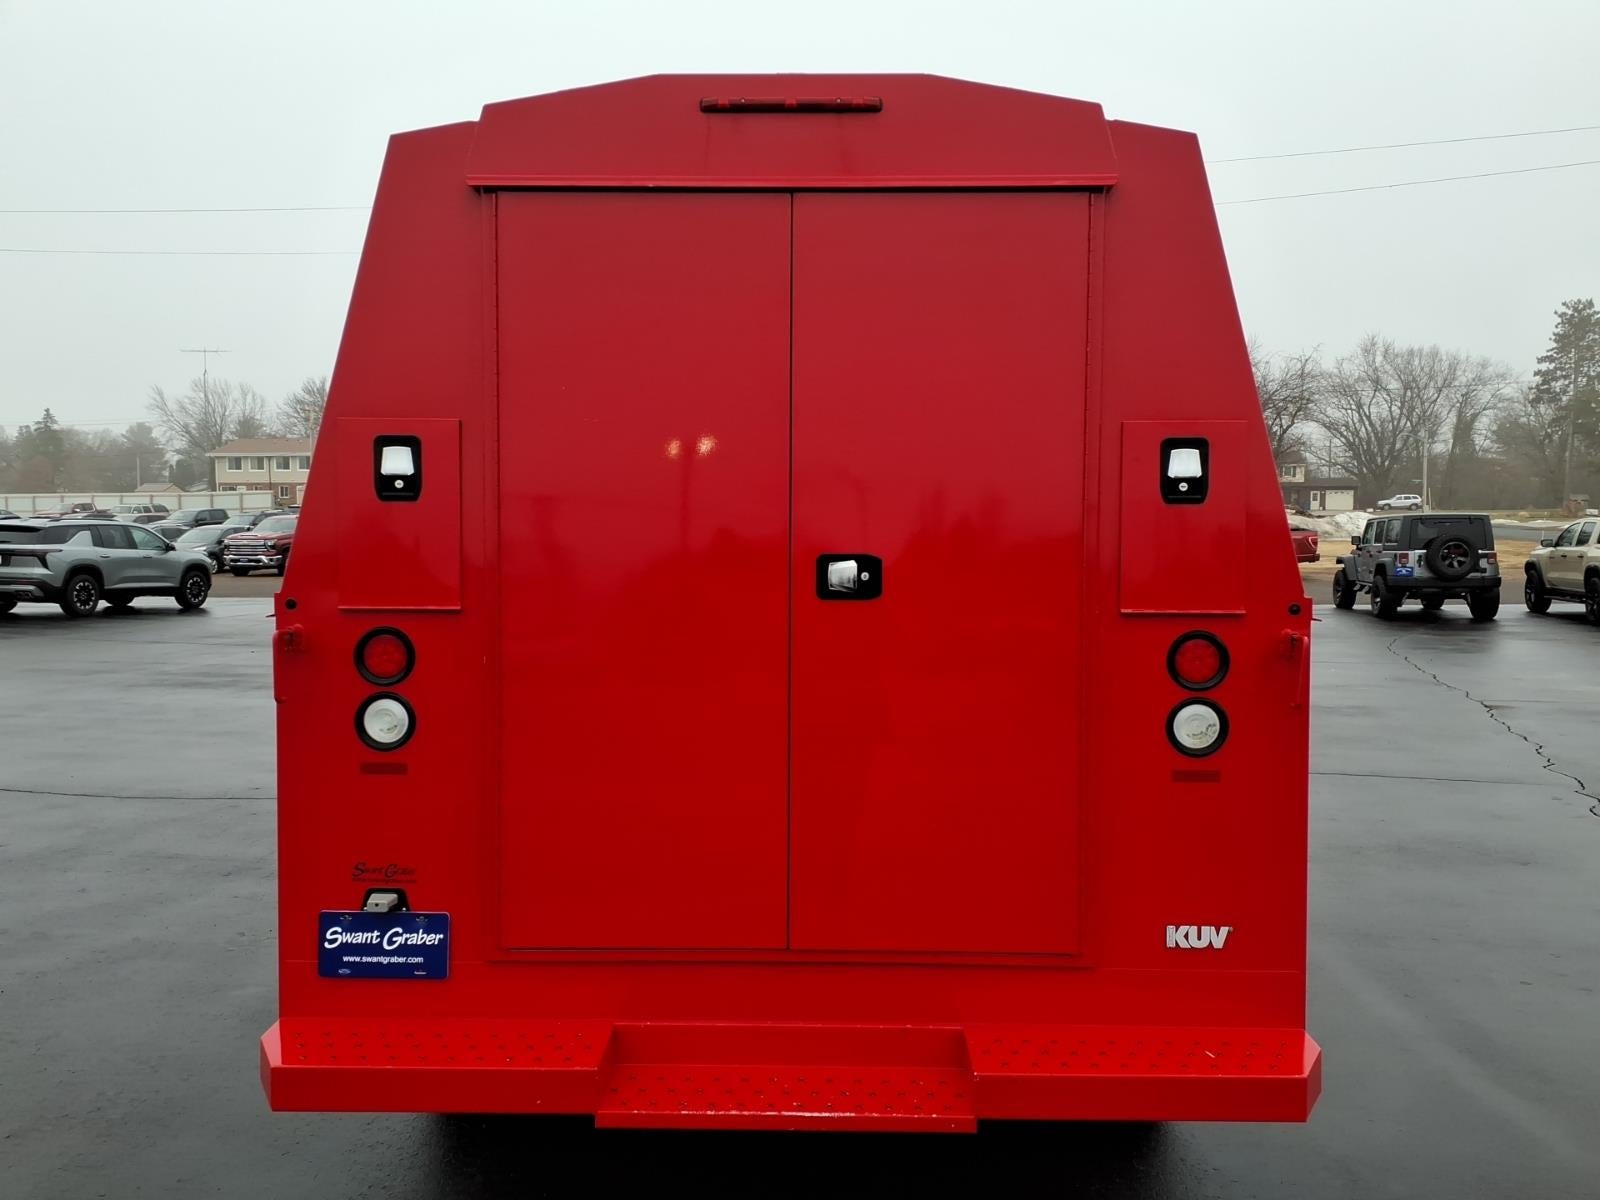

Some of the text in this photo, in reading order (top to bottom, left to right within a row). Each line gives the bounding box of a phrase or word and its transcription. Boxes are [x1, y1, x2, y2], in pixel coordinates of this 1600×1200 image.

[324, 926, 444, 950] Swant Graber
[1166, 925, 1229, 949] KUV
[342, 955, 424, 965] www.swantgraber.com
